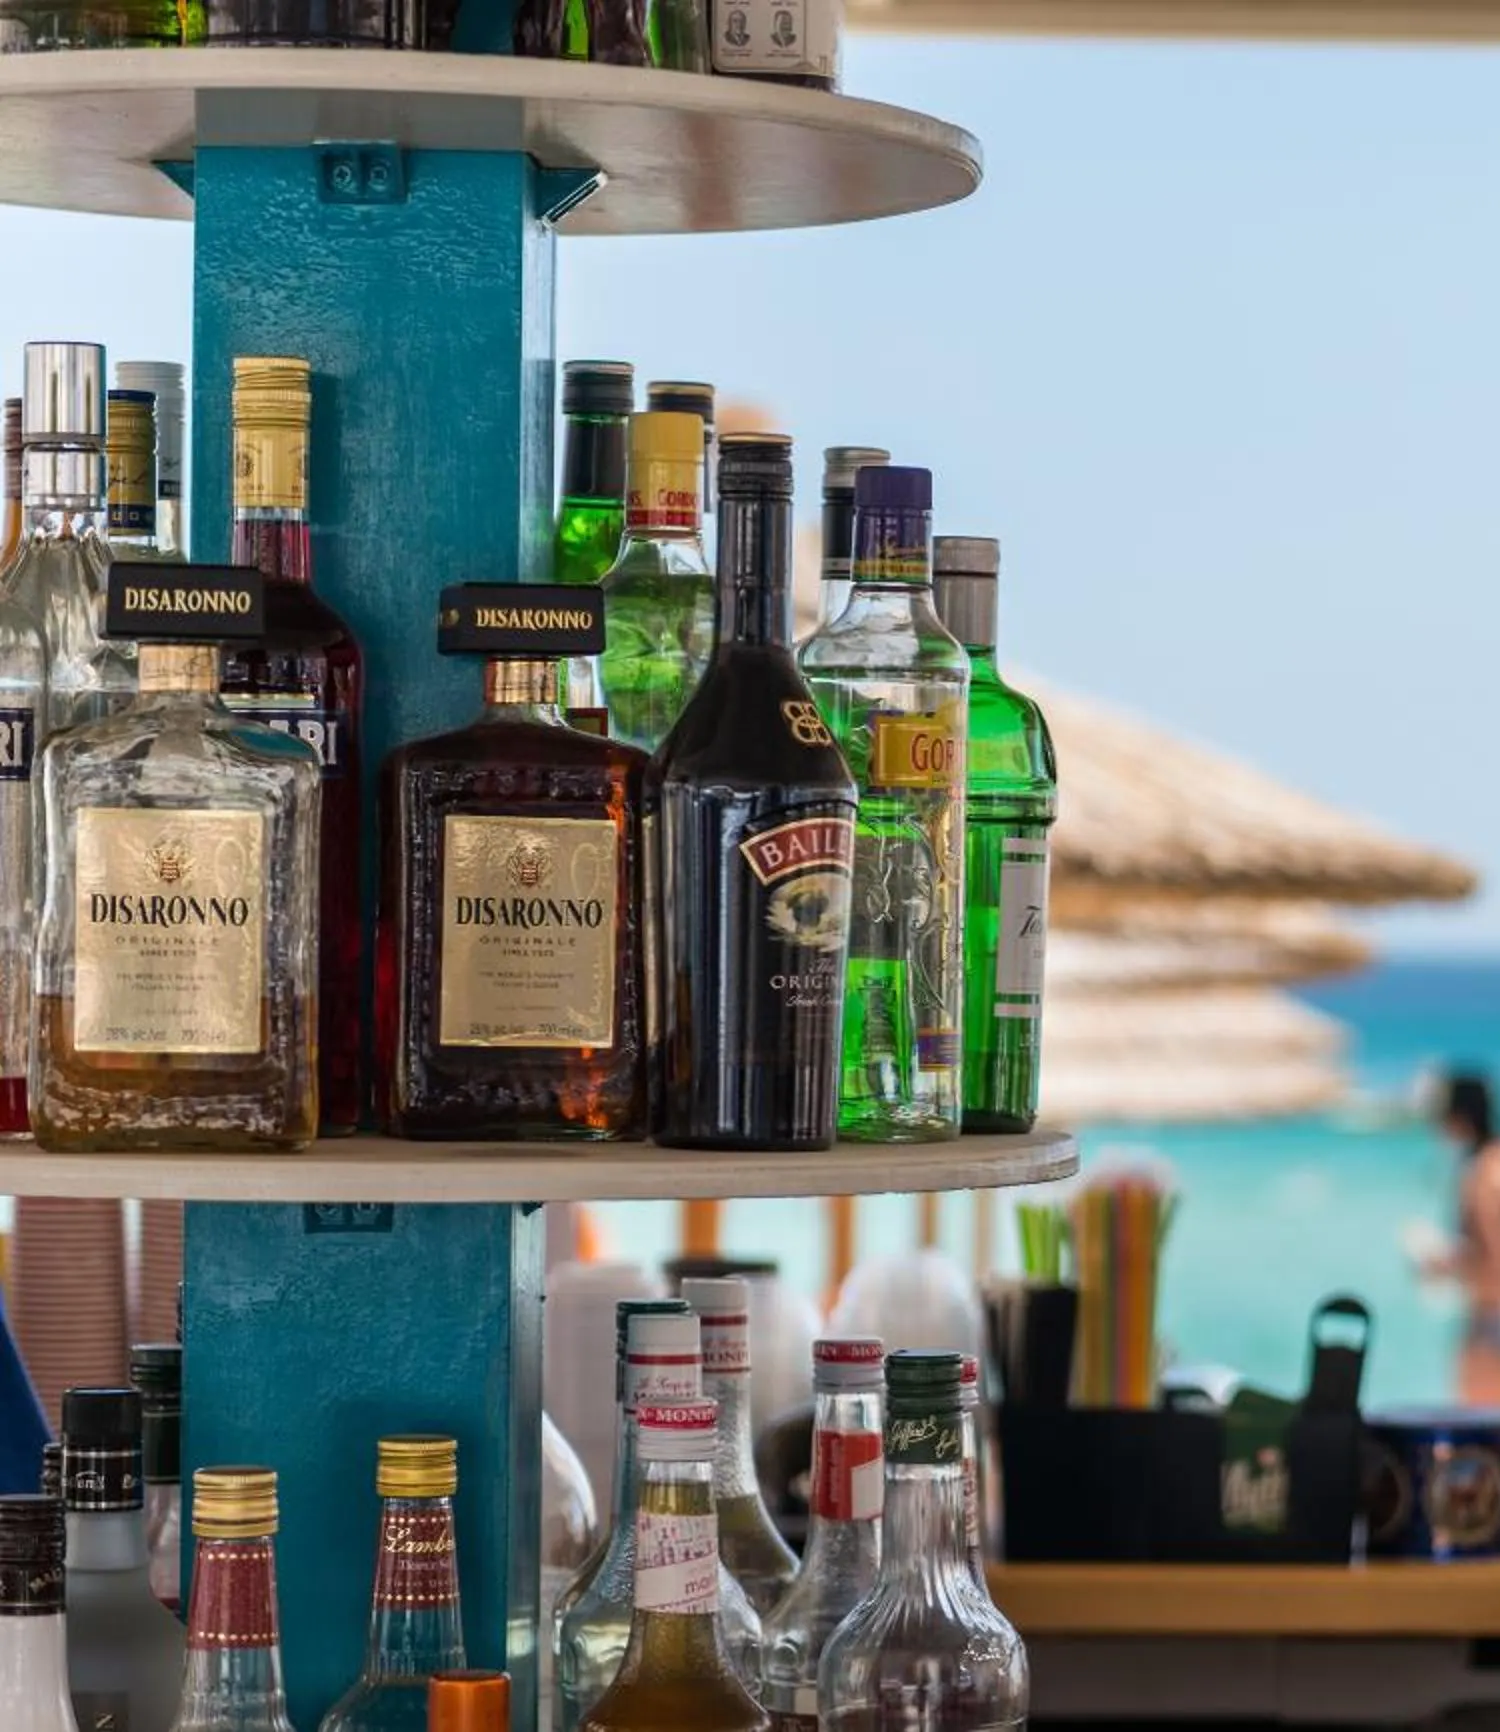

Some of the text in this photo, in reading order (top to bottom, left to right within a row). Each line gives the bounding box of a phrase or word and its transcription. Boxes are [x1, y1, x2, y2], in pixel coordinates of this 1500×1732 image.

[125, 586, 251, 613] DISARONNO
[475, 607, 593, 631] DISARONNO
[90, 893, 249, 928] DISARONNO
[456, 896, 603, 929] DISARONNO
[479, 935, 576, 947] ORIGINALE
